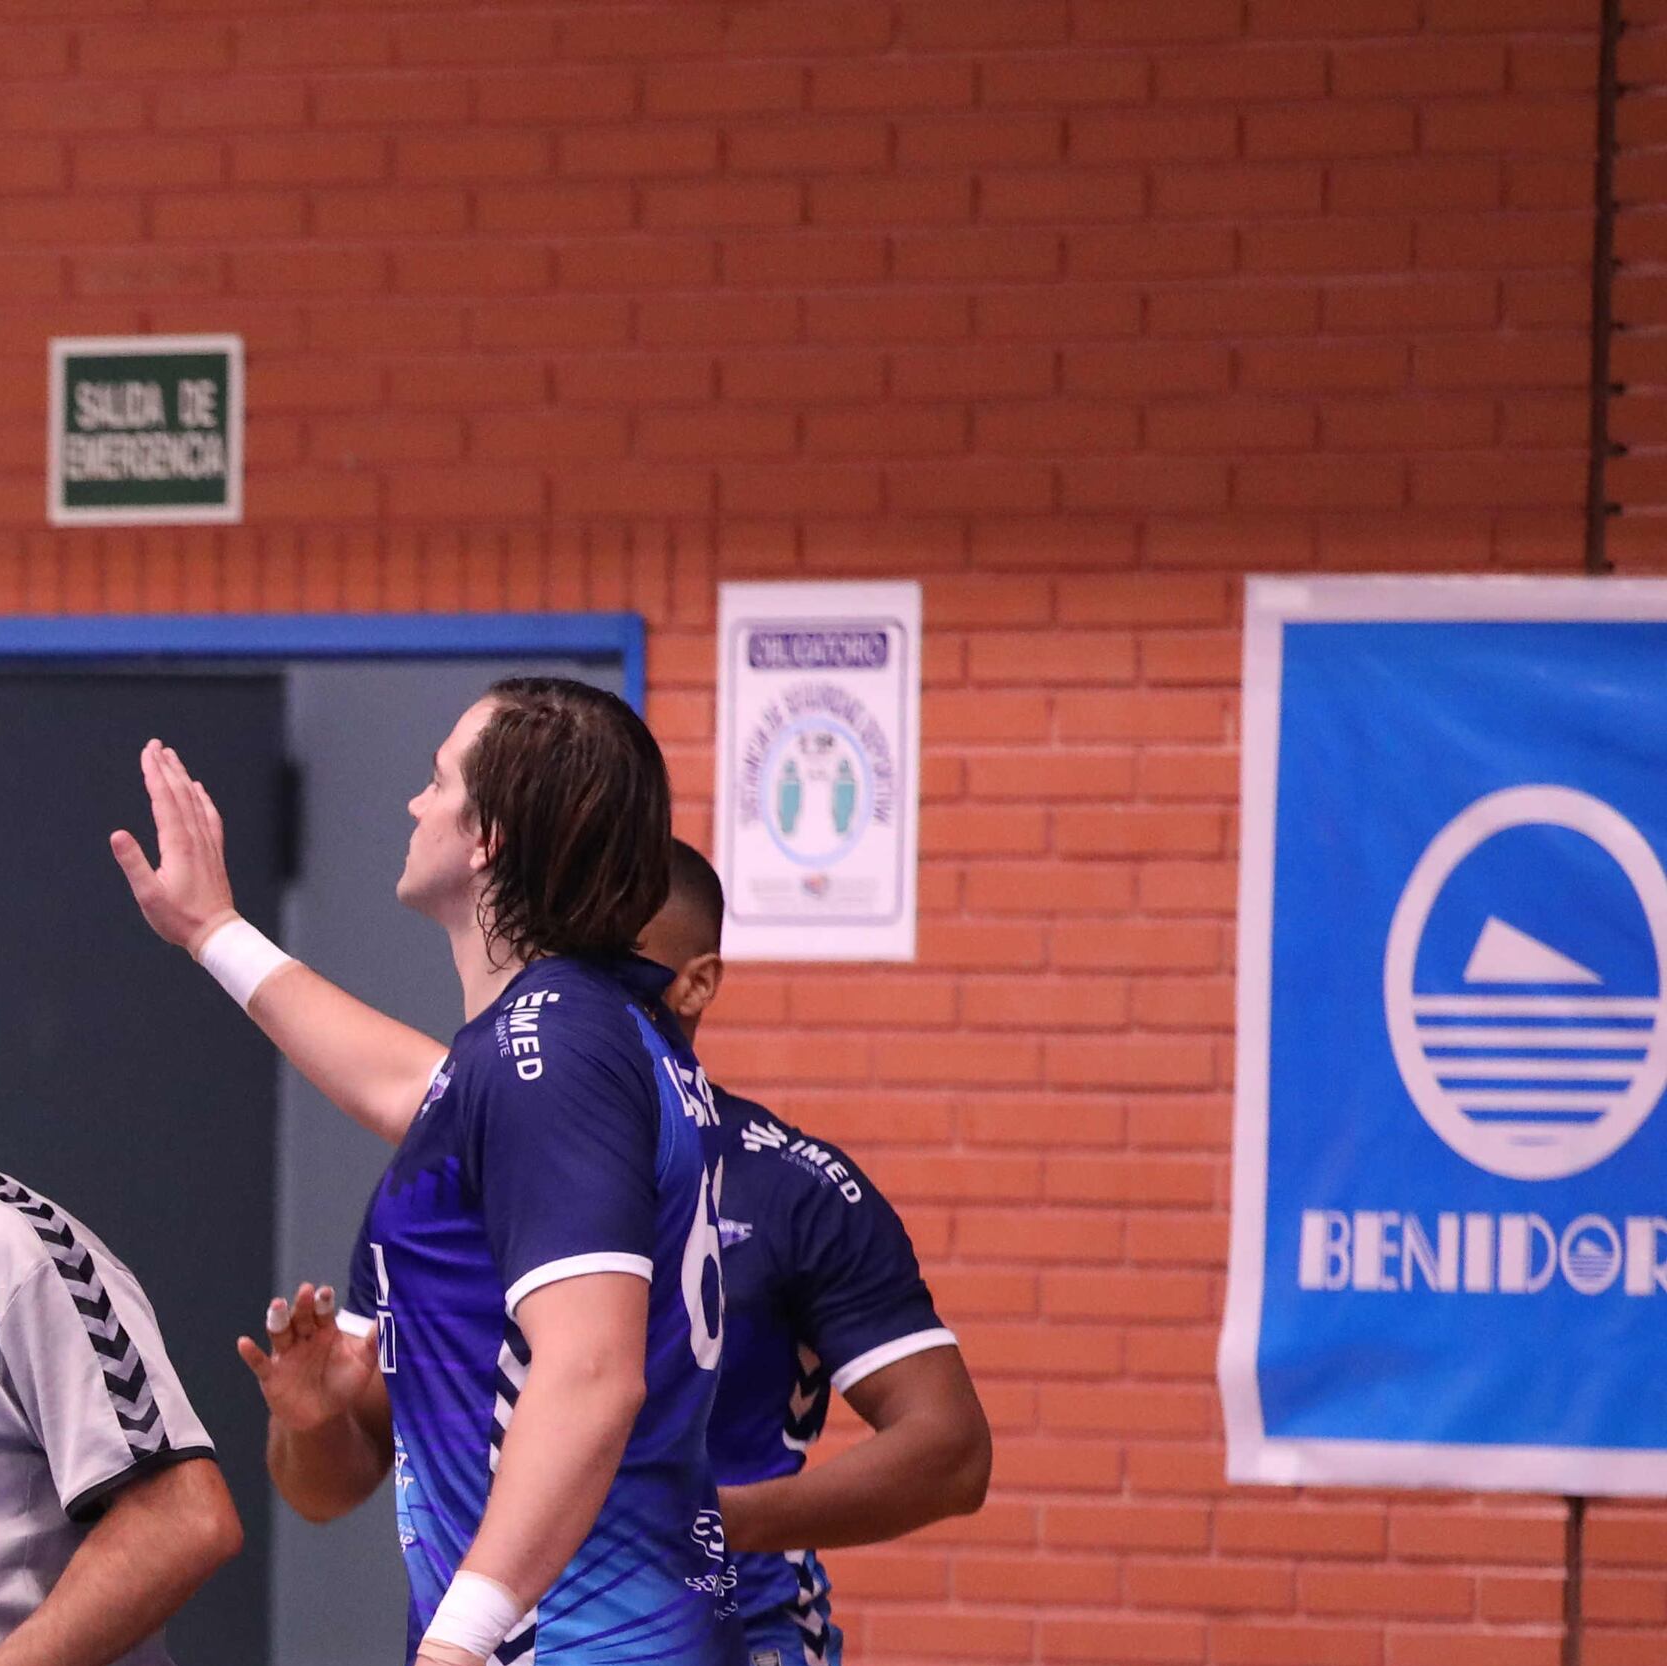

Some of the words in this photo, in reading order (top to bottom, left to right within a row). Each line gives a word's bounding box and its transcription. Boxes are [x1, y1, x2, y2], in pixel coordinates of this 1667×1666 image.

[73, 380, 166, 431] SALIDA
[177, 378, 217, 428] DE
[509, 1008, 543, 1081] IMED
[788, 1139, 862, 1204] IMED
